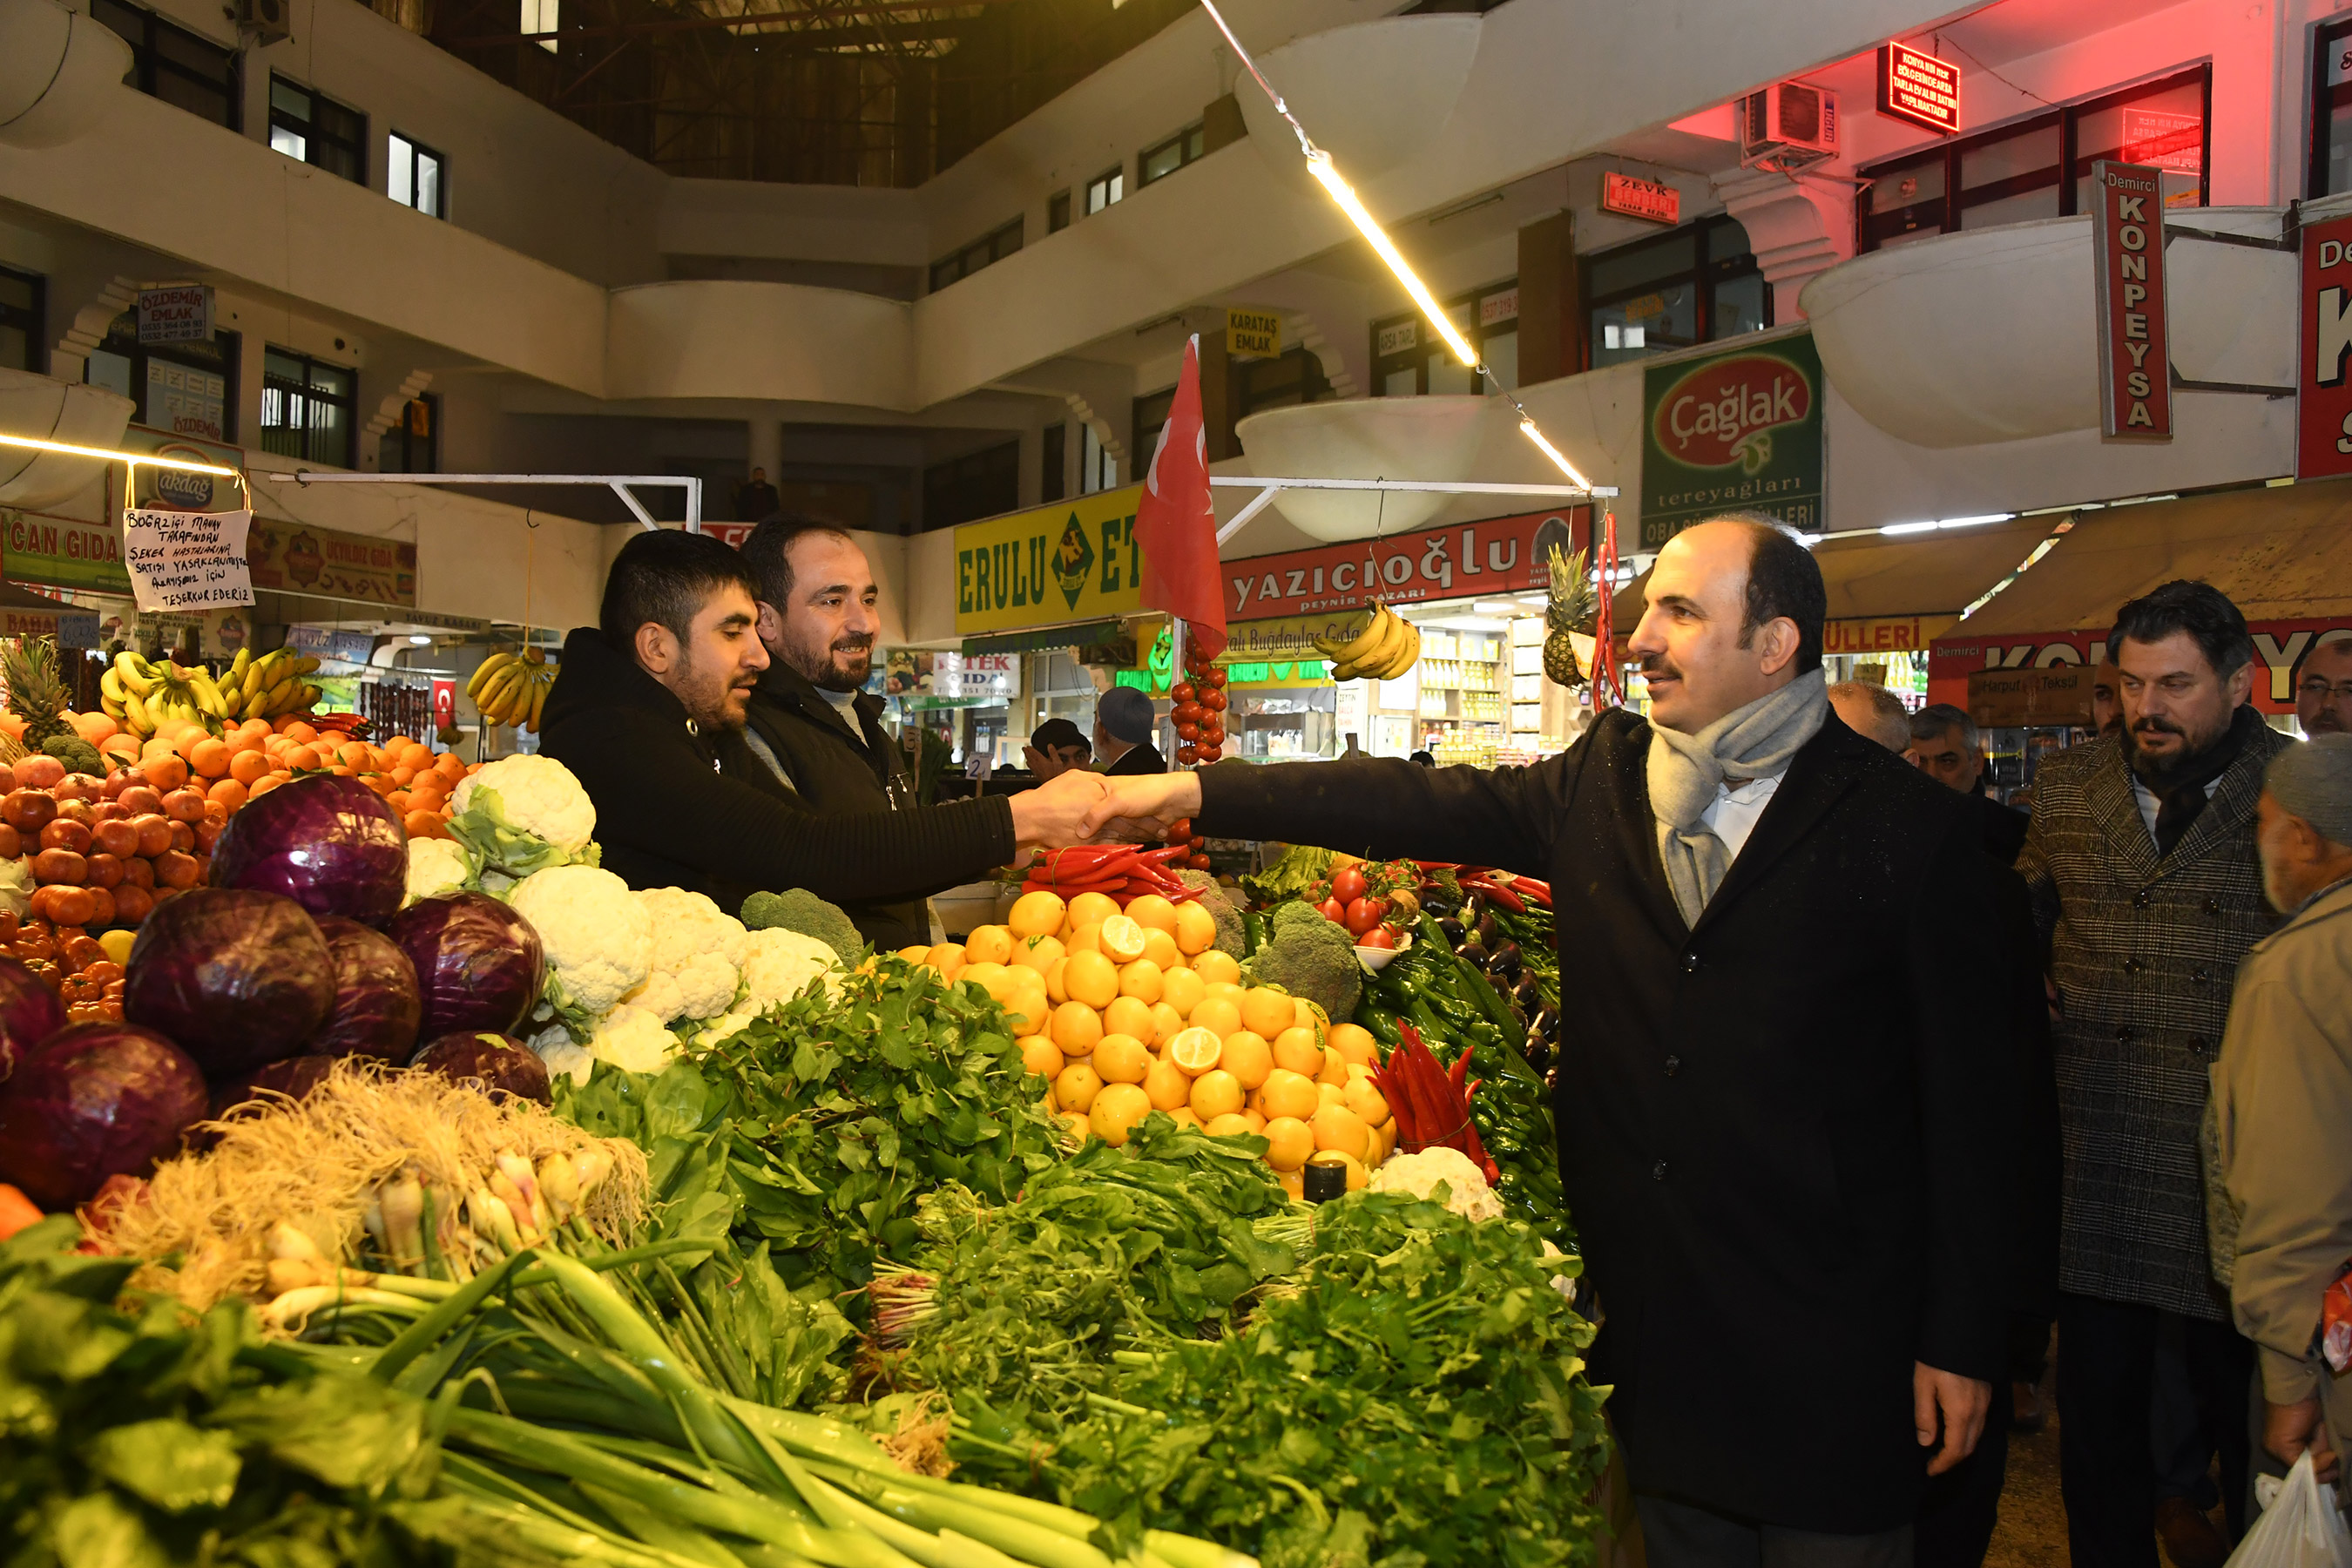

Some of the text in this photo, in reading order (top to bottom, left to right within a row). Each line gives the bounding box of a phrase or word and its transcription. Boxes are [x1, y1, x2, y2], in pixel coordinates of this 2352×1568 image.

[1893, 76, 1914, 93] TARLA
[1621, 179, 1667, 197] ZEVK
[2108, 172, 2155, 193] Demirci
[141, 290, 202, 311] ÖZDEMİR
[152, 308, 193, 321] EMLAK
[2119, 195, 2154, 429] KONPEYSA
[141, 323, 161, 332] 0535
[193, 319, 203, 328] 93
[1230, 313, 1277, 338] KARATAŞ
[141, 332, 161, 341] 0532
[1235, 332, 1271, 353] EMLAK
[1671, 376, 1797, 449] Çağlak
[173, 416, 220, 442] ÖZDEMİR
[159, 474, 211, 502] akdağ
[1659, 477, 1801, 507] tereyağları
[10, 520, 119, 564] CAN GIDA
[129, 547, 165, 562] ŞEKER
[959, 535, 1046, 614] ERULU
[1824, 617, 1920, 652] ÜLLERİ
[1936, 645, 1979, 657] Demirci
[1983, 675, 2078, 694] Harput Tekstil
